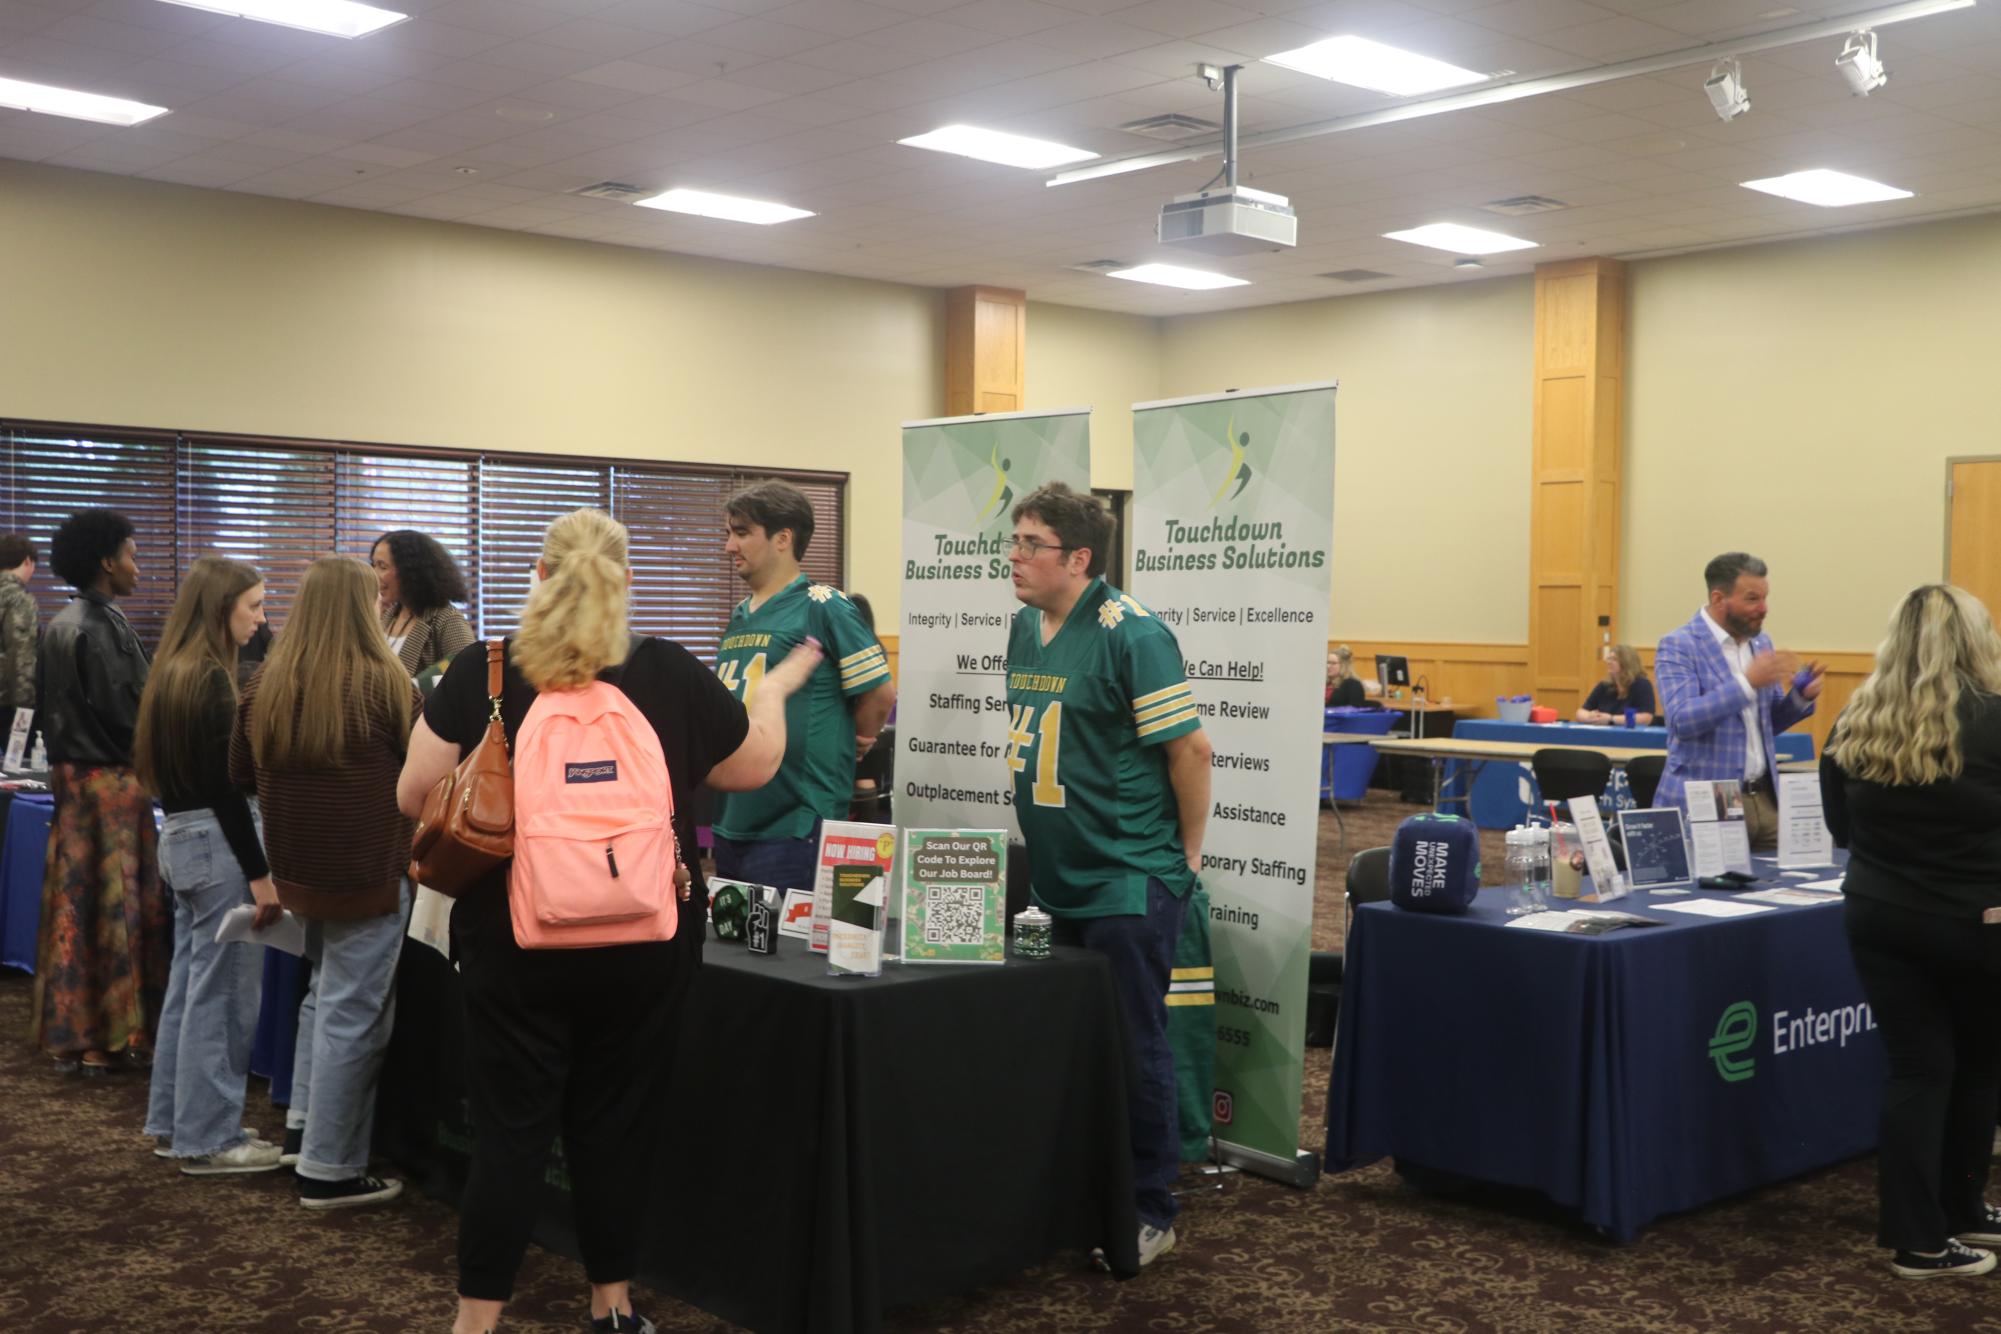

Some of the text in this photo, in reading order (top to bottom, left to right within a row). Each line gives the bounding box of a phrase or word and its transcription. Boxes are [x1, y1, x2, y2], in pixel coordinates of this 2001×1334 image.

[1165, 515, 1282, 544] Touchdown
[934, 531, 1002, 556] Touchd
[1135, 543, 1326, 572] Business Solutions
[905, 558, 983, 580] Business
[908, 612, 952, 629] Integrity
[961, 612, 1002, 626] Service
[1193, 607, 1236, 623] Service
[1247, 607, 1314, 623] Excellence
[956, 654, 1008, 671] We Offe
[1199, 660, 1223, 676] Can
[1227, 660, 1264, 679] Help!
[1009, 672, 1068, 694] TOUCHDOWN
[929, 693, 981, 714] Staffing
[1220, 701, 1270, 720] Review
[908, 737, 977, 757] Guarantee
[980, 741, 1001, 758] for
[1211, 751, 1270, 772] terviews
[906, 782, 999, 805] Outplacement
[1212, 802, 1286, 826] Assistance
[926, 841, 988, 853] Scan Our QR
[917, 855, 996, 866] Code To Explore
[1201, 854, 1306, 886] porary Staffing
[1411, 840, 1429, 897] MOVES
[1424, 842, 1436, 896] UNEXPECTED
[1432, 842, 1449, 889] MAKE
[919, 868, 993, 879] Our Job Board!
[1208, 904, 1260, 931] raining
[1773, 1002, 1878, 1055] Enterpri
